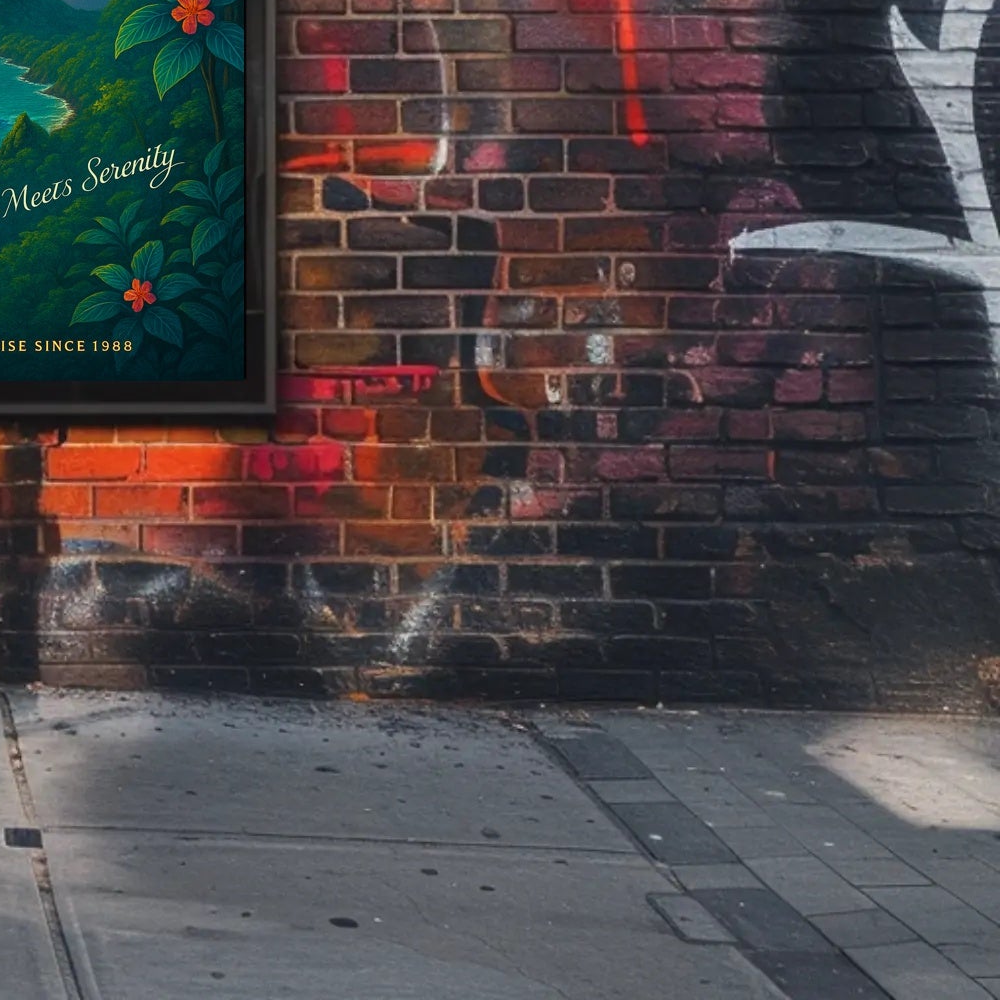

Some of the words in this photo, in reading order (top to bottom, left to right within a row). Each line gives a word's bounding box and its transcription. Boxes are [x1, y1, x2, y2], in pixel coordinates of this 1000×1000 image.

[81, 143, 185, 190] Serenity
[35, 340, 86, 352] SINCE
[92, 340, 133, 352] 1988
